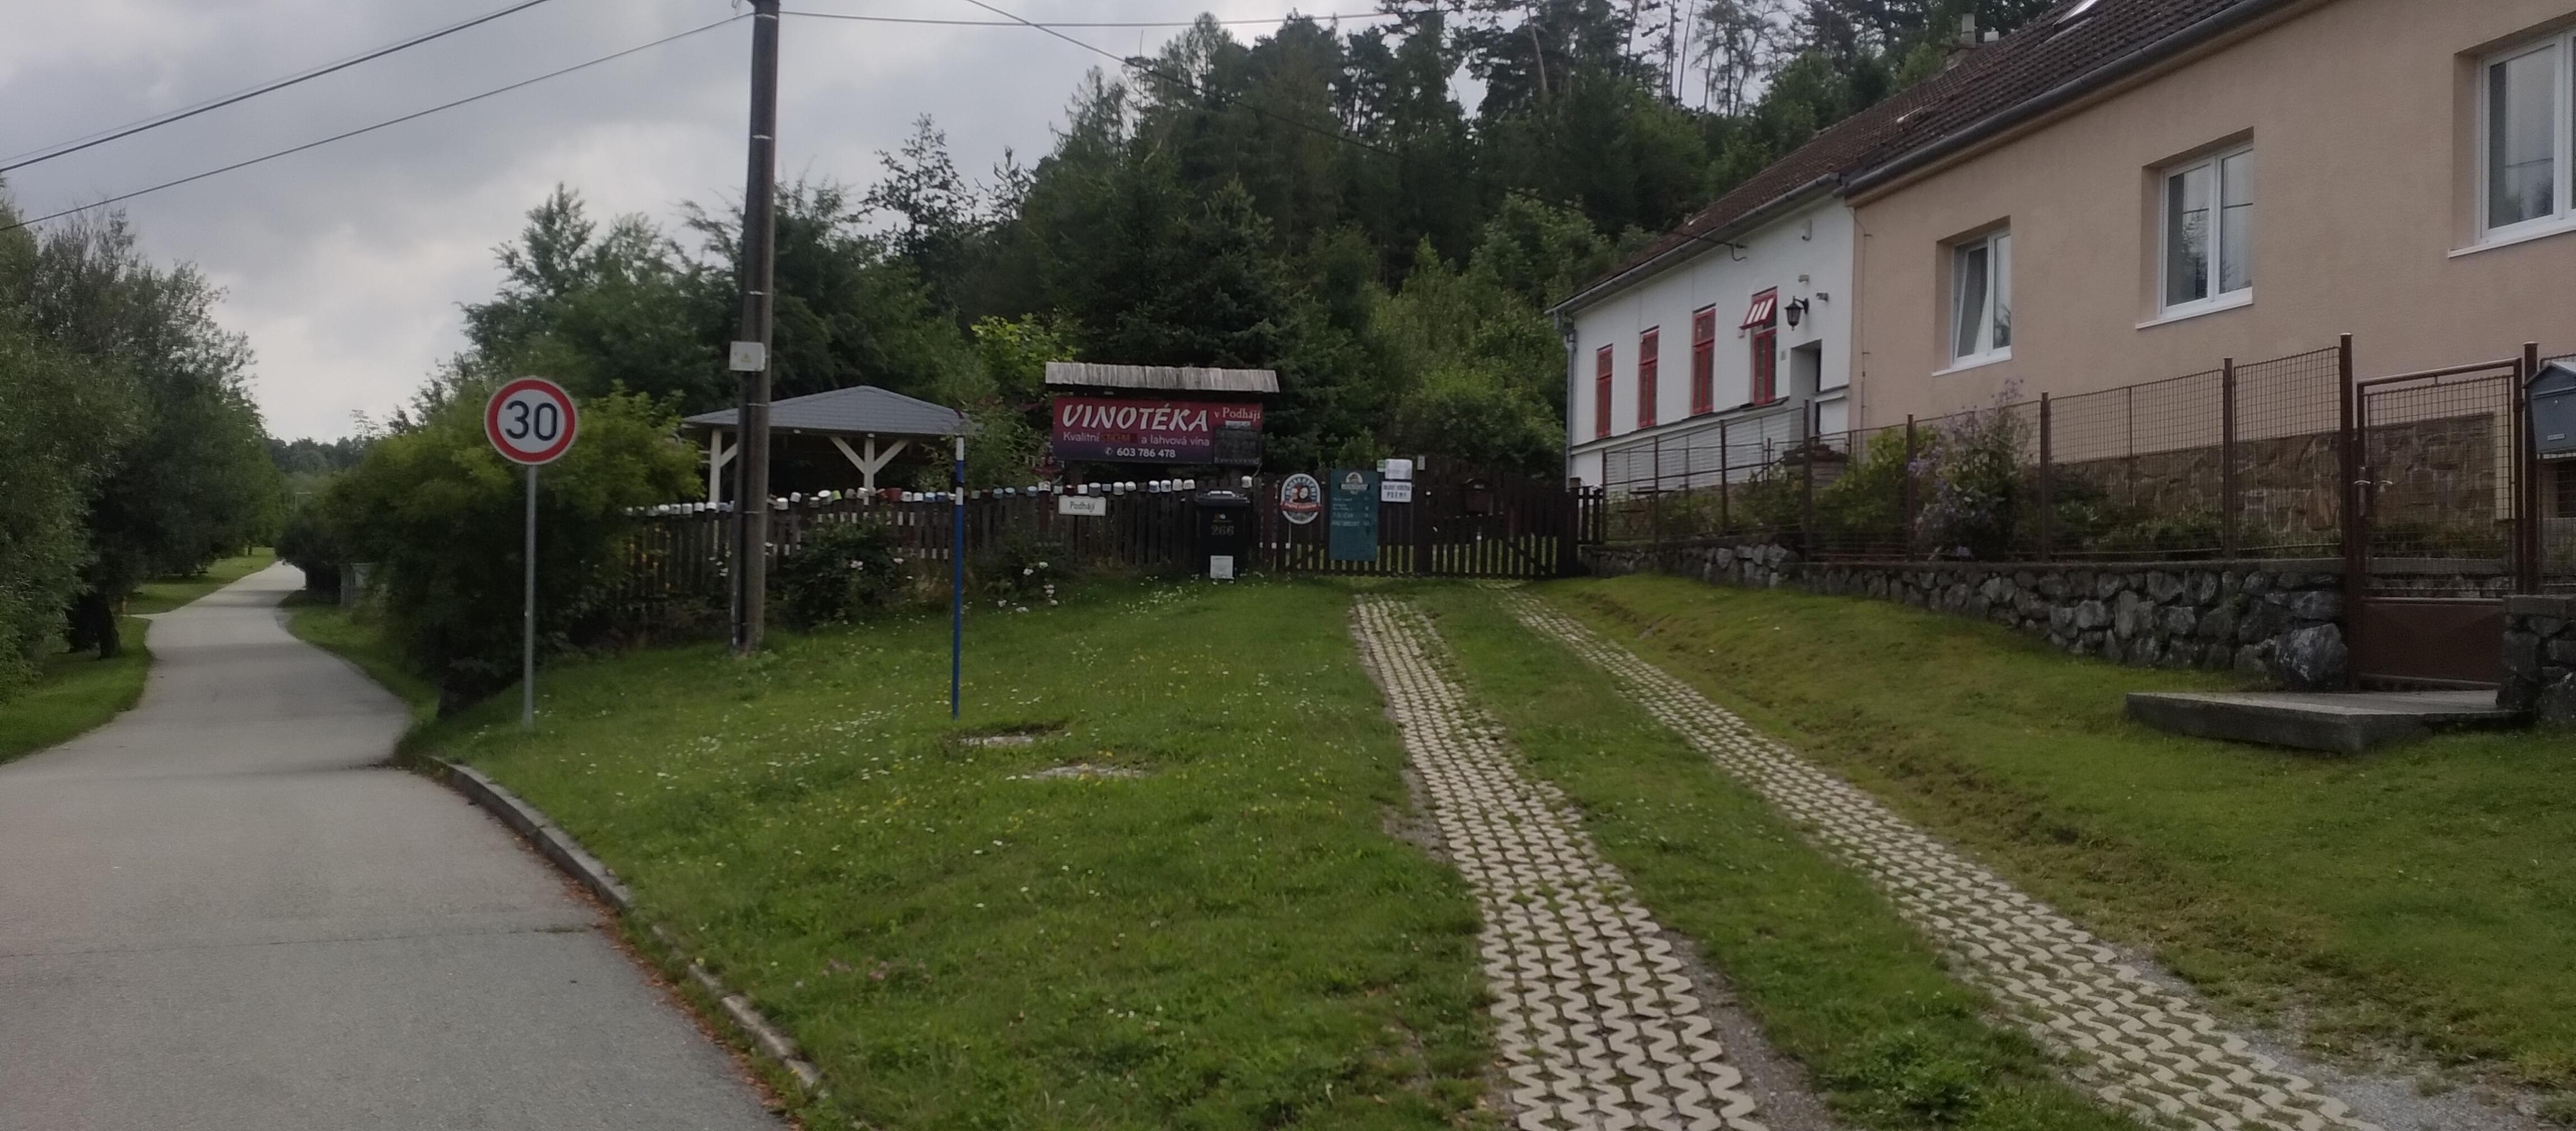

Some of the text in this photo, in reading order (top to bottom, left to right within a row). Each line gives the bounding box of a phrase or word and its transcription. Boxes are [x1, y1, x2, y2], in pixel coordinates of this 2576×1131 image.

[505, 400, 557, 442] 30
[1062, 403, 1208, 432] VINOTÉKA
[1222, 407, 1261, 422] Podhájí
[1063, 432, 1099, 443] Kvalitní
[1150, 435, 1187, 445] lahvová
[1190, 437, 1210, 447] vína
[1116, 447, 1176, 458] 603 786 478
[1211, 525, 1235, 536] 266
